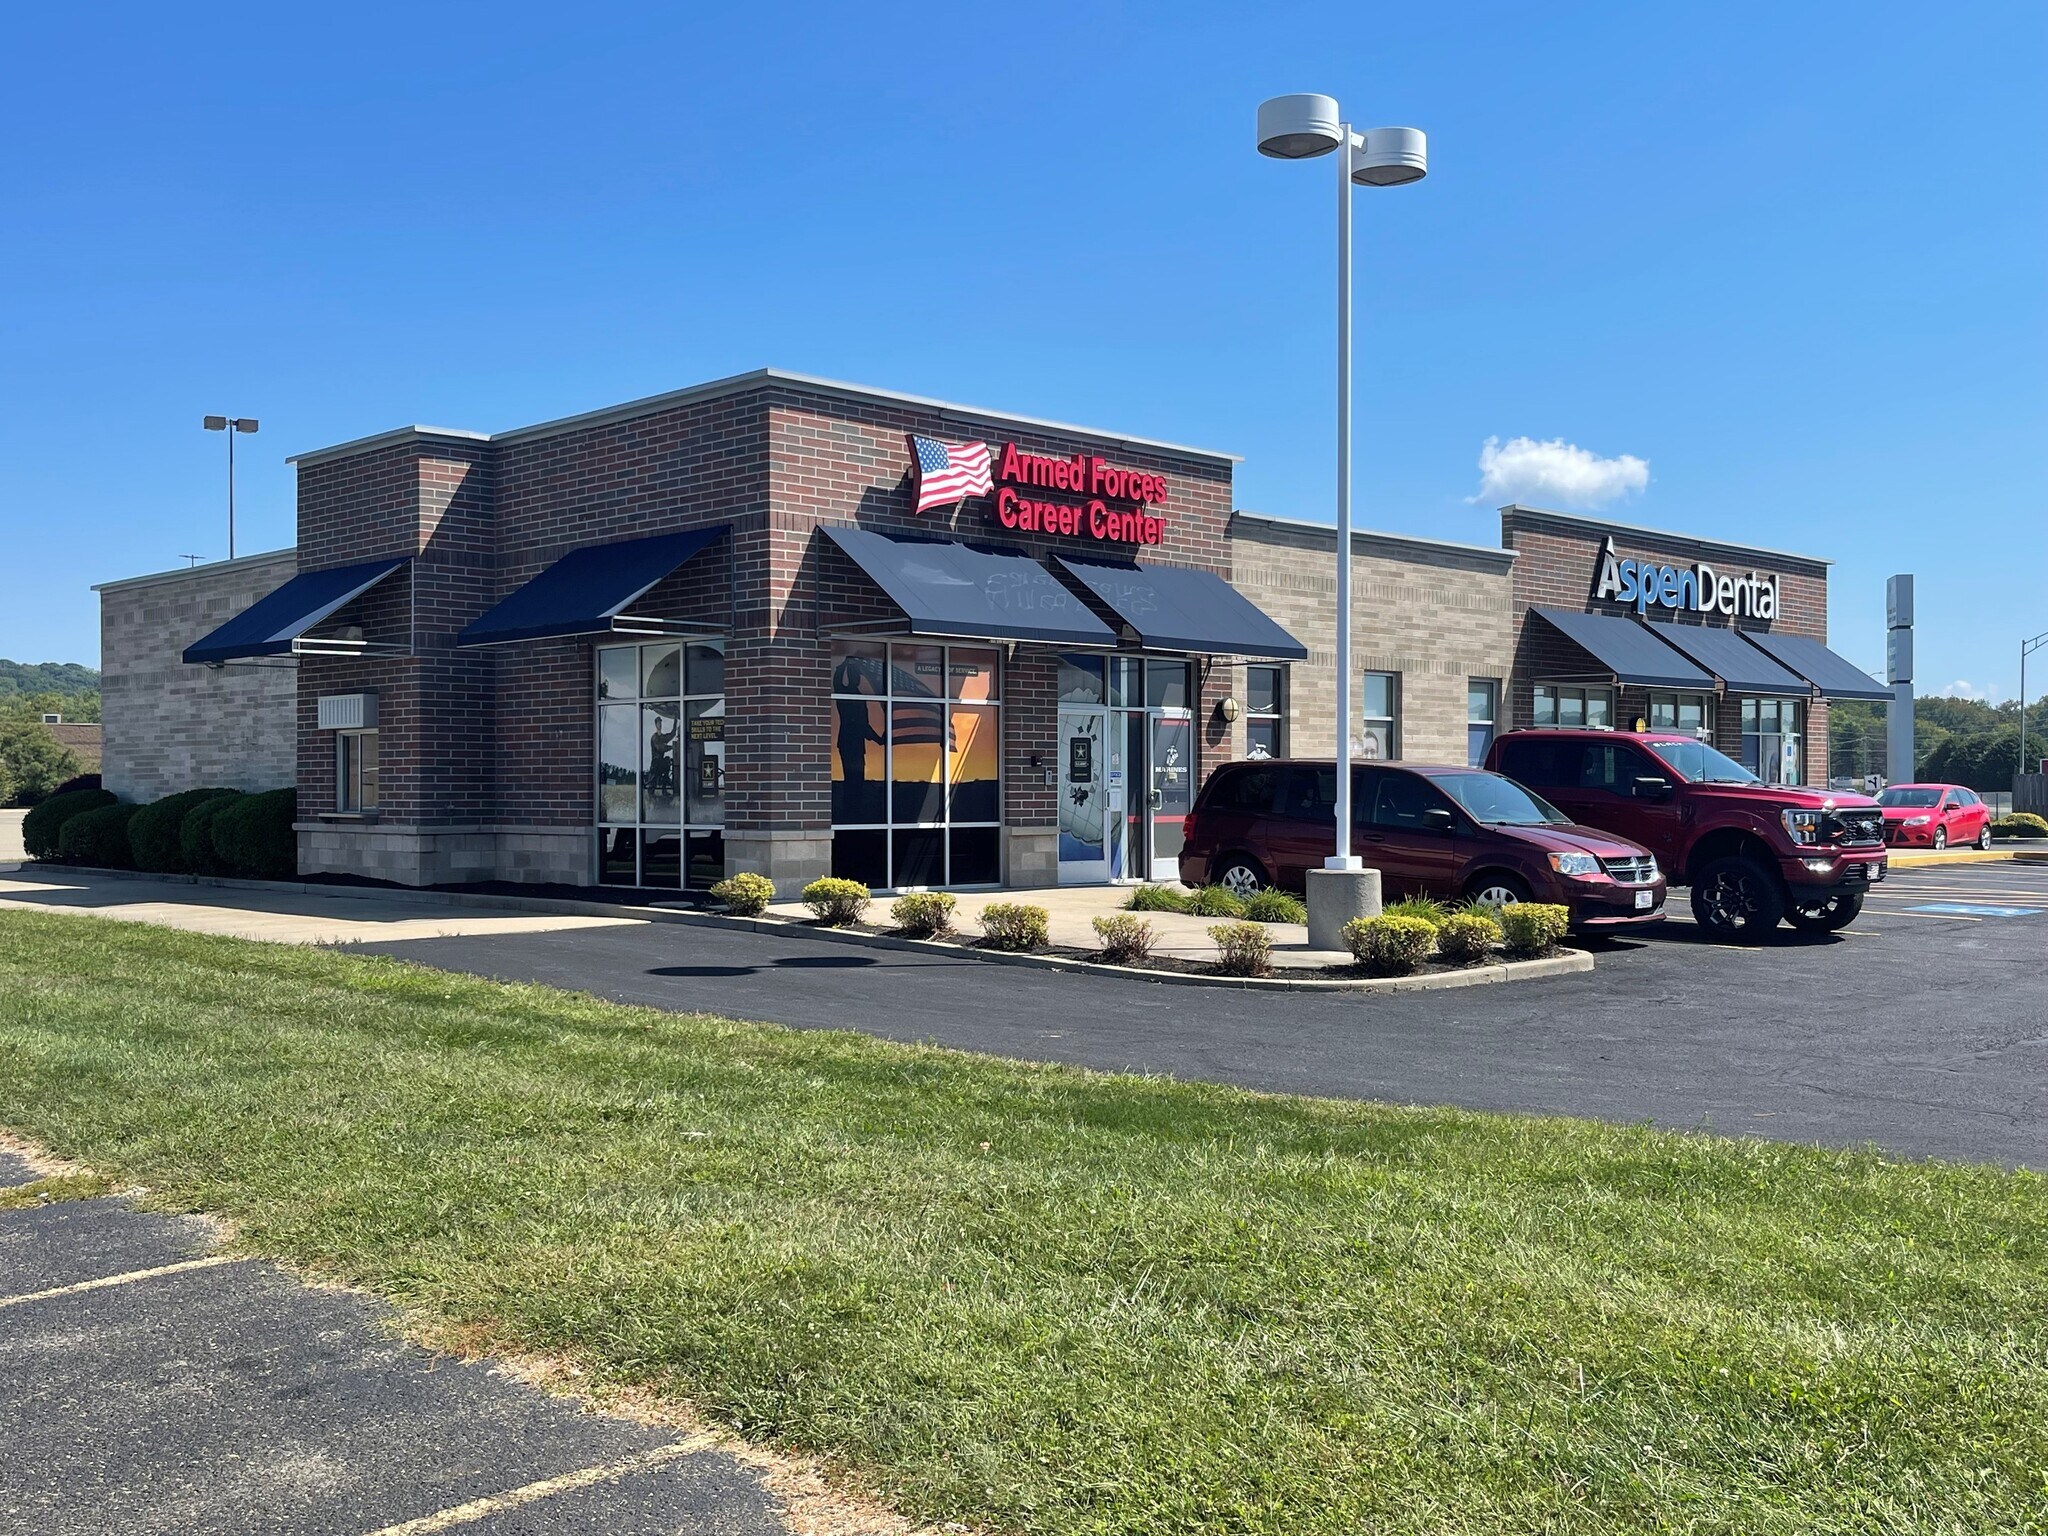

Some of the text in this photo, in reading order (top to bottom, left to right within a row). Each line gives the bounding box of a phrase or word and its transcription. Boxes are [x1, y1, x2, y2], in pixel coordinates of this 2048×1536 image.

[1001, 441, 1168, 504] Armed Forces
[998, 487, 1166, 545] Career Center
